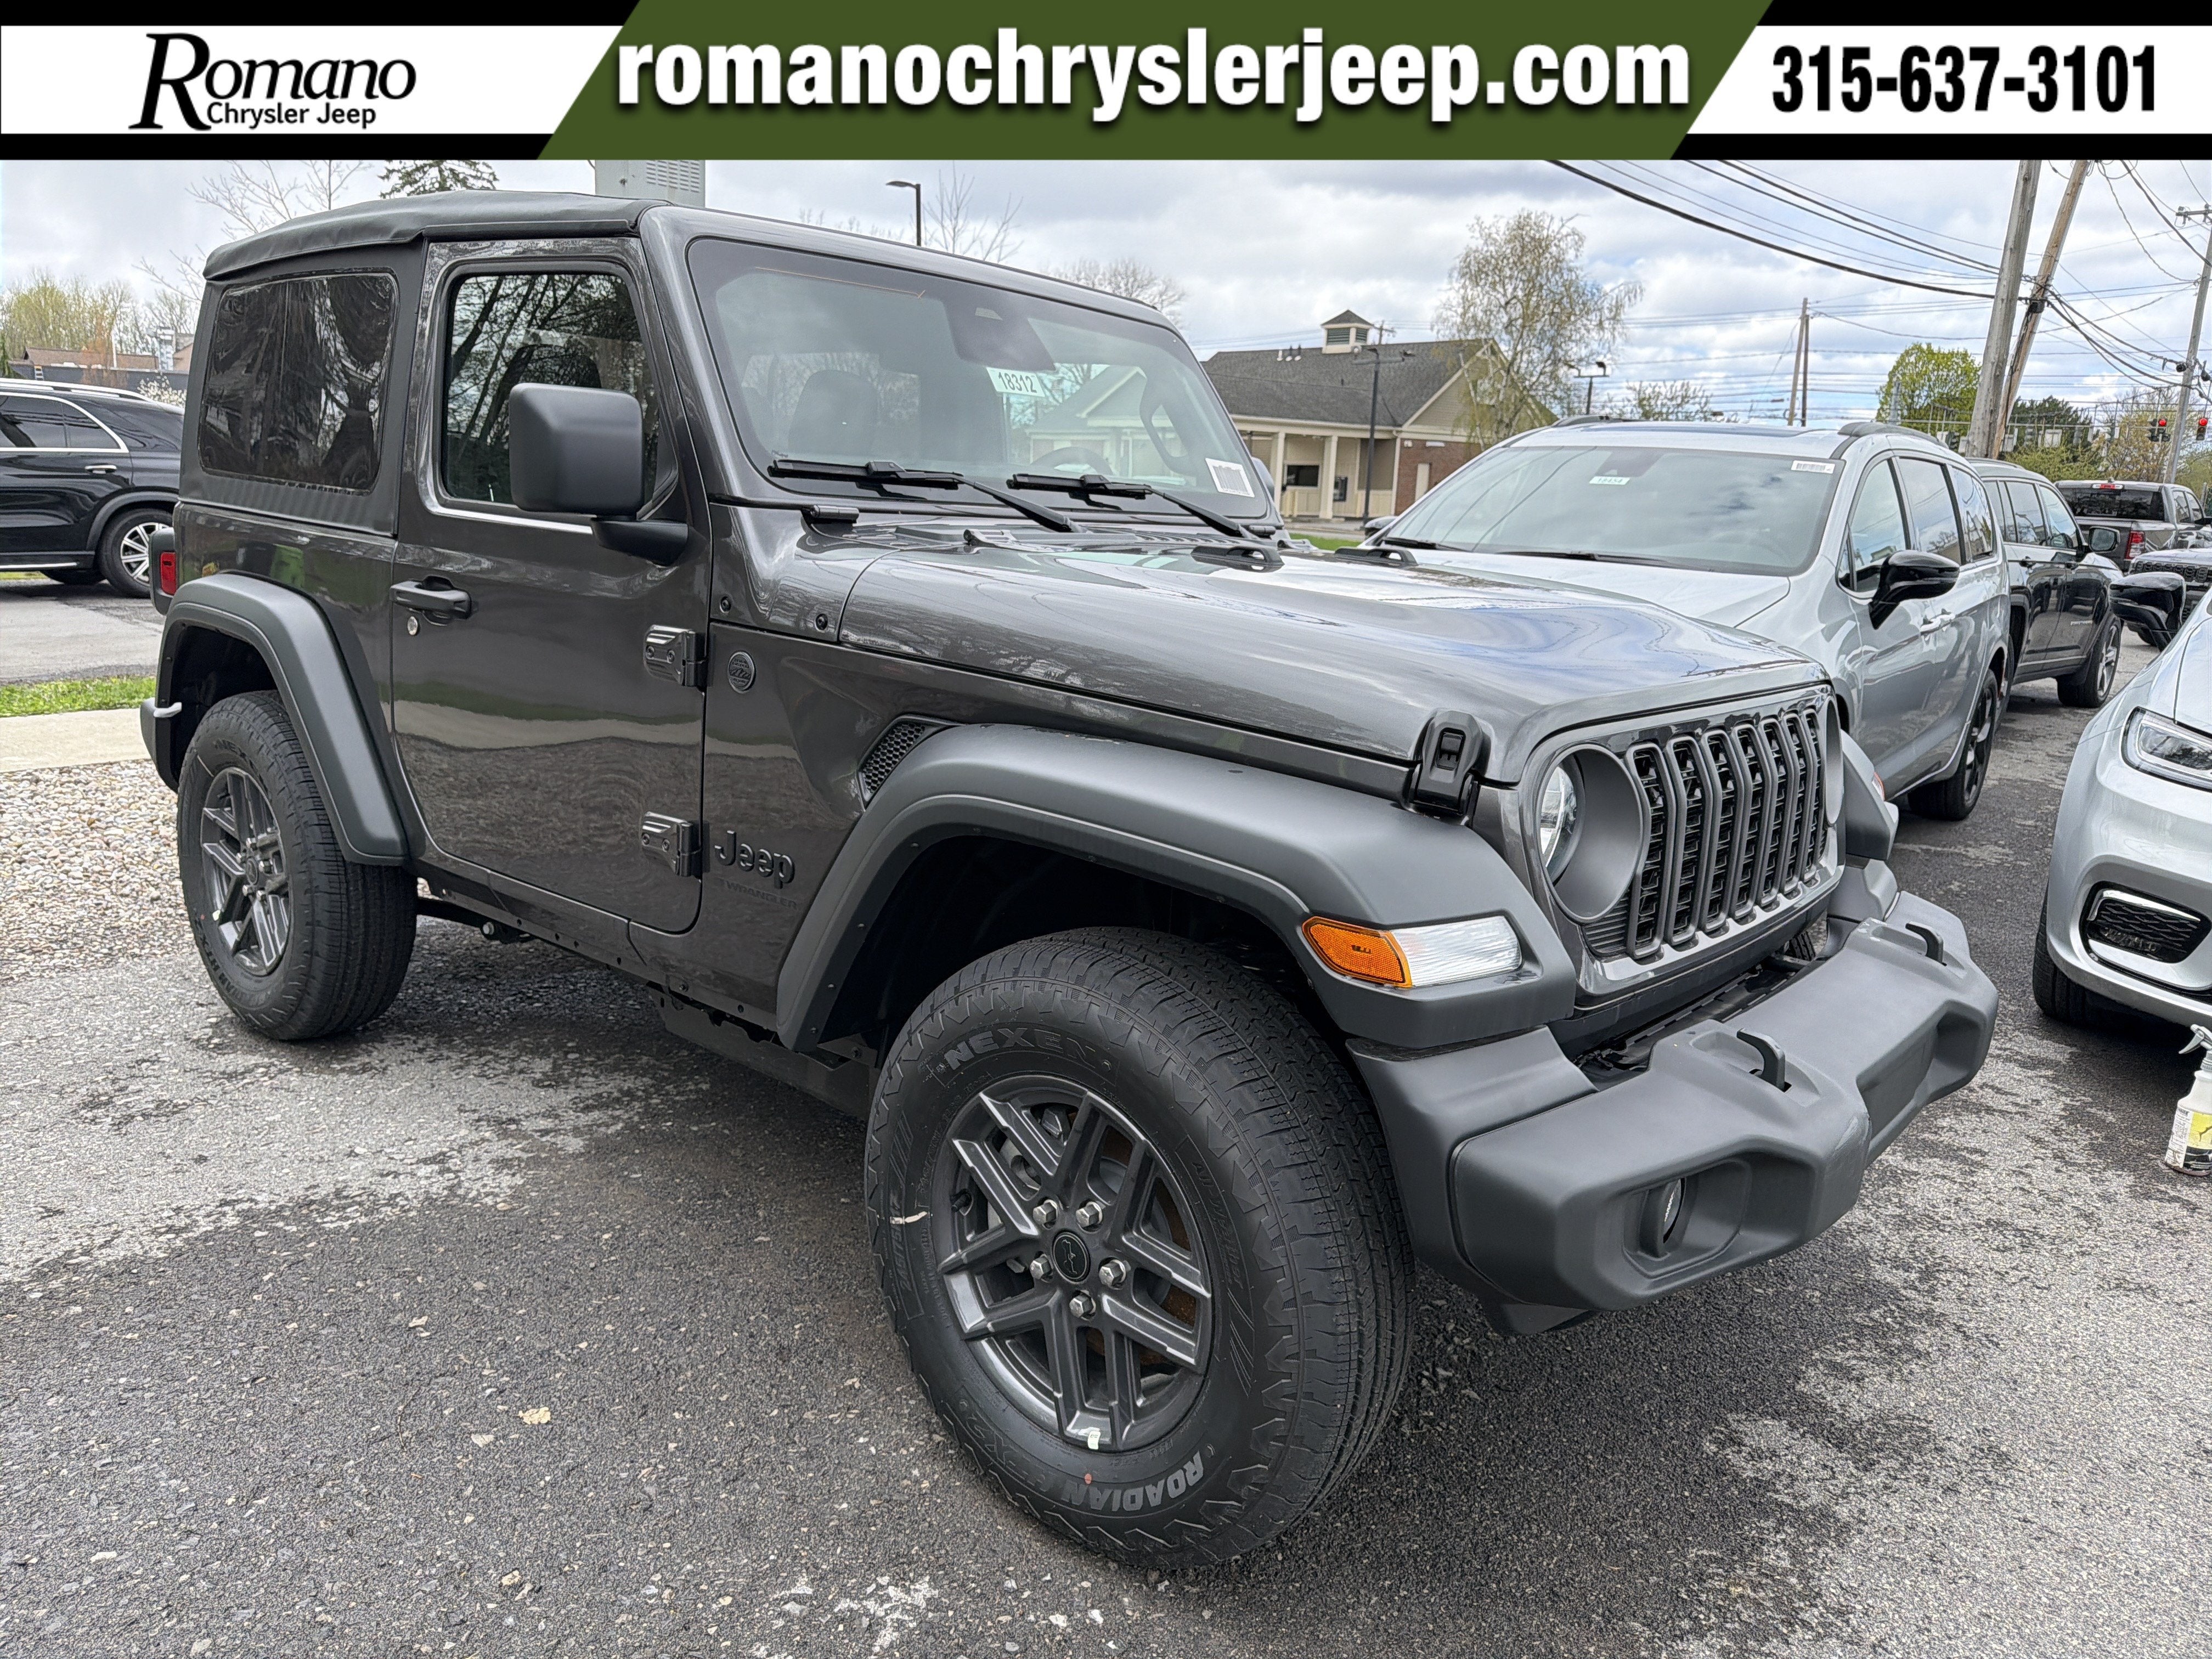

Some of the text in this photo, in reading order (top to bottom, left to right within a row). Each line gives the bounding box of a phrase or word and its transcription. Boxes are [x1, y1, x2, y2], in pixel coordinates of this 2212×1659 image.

[998, 371, 1037, 393] 18312
[714, 830, 795, 889] Jeep
[944, 1027, 1096, 1069] NEXEN
[889, 1189, 912, 1291] 245/7517
[1060, 1451, 1204, 1511] ROADIAN
